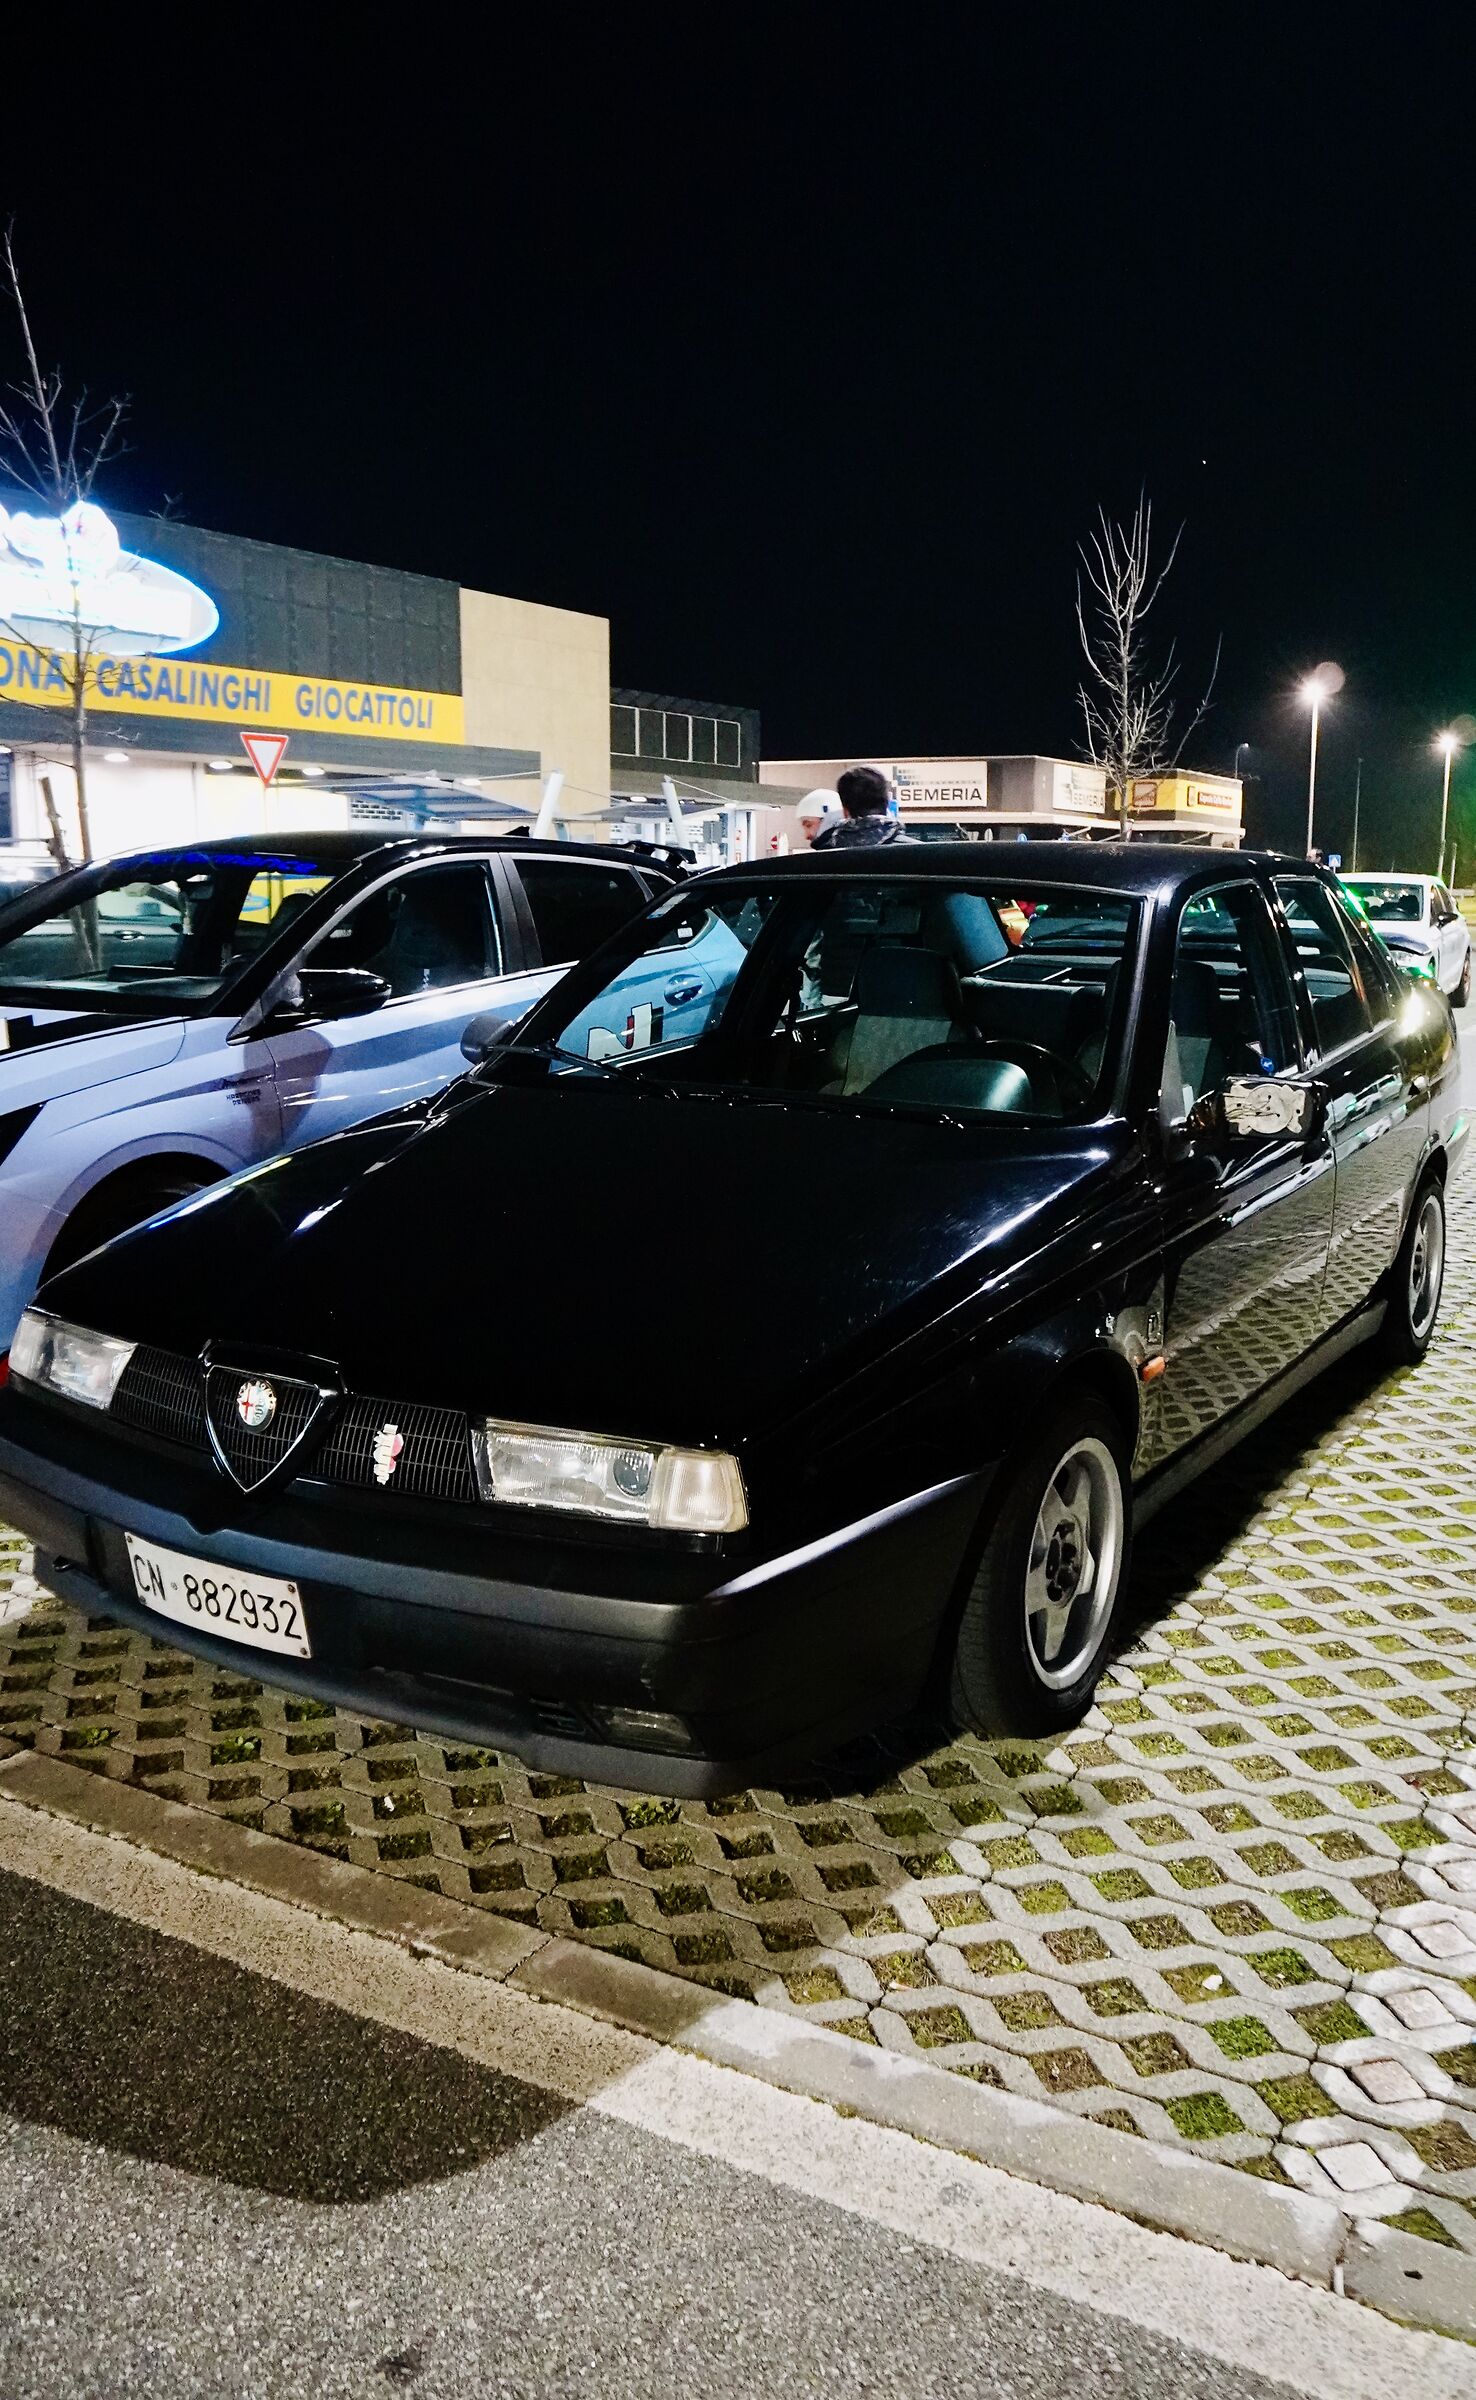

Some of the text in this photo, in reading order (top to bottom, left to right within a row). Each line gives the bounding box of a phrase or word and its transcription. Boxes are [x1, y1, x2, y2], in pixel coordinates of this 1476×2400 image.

[97, 659, 271, 713] CASALINGHI
[295, 683, 433, 729] GIOCATTOLI
[900, 788, 982, 801] SEMERIA
[133, 1554, 302, 1640] CN 882932
